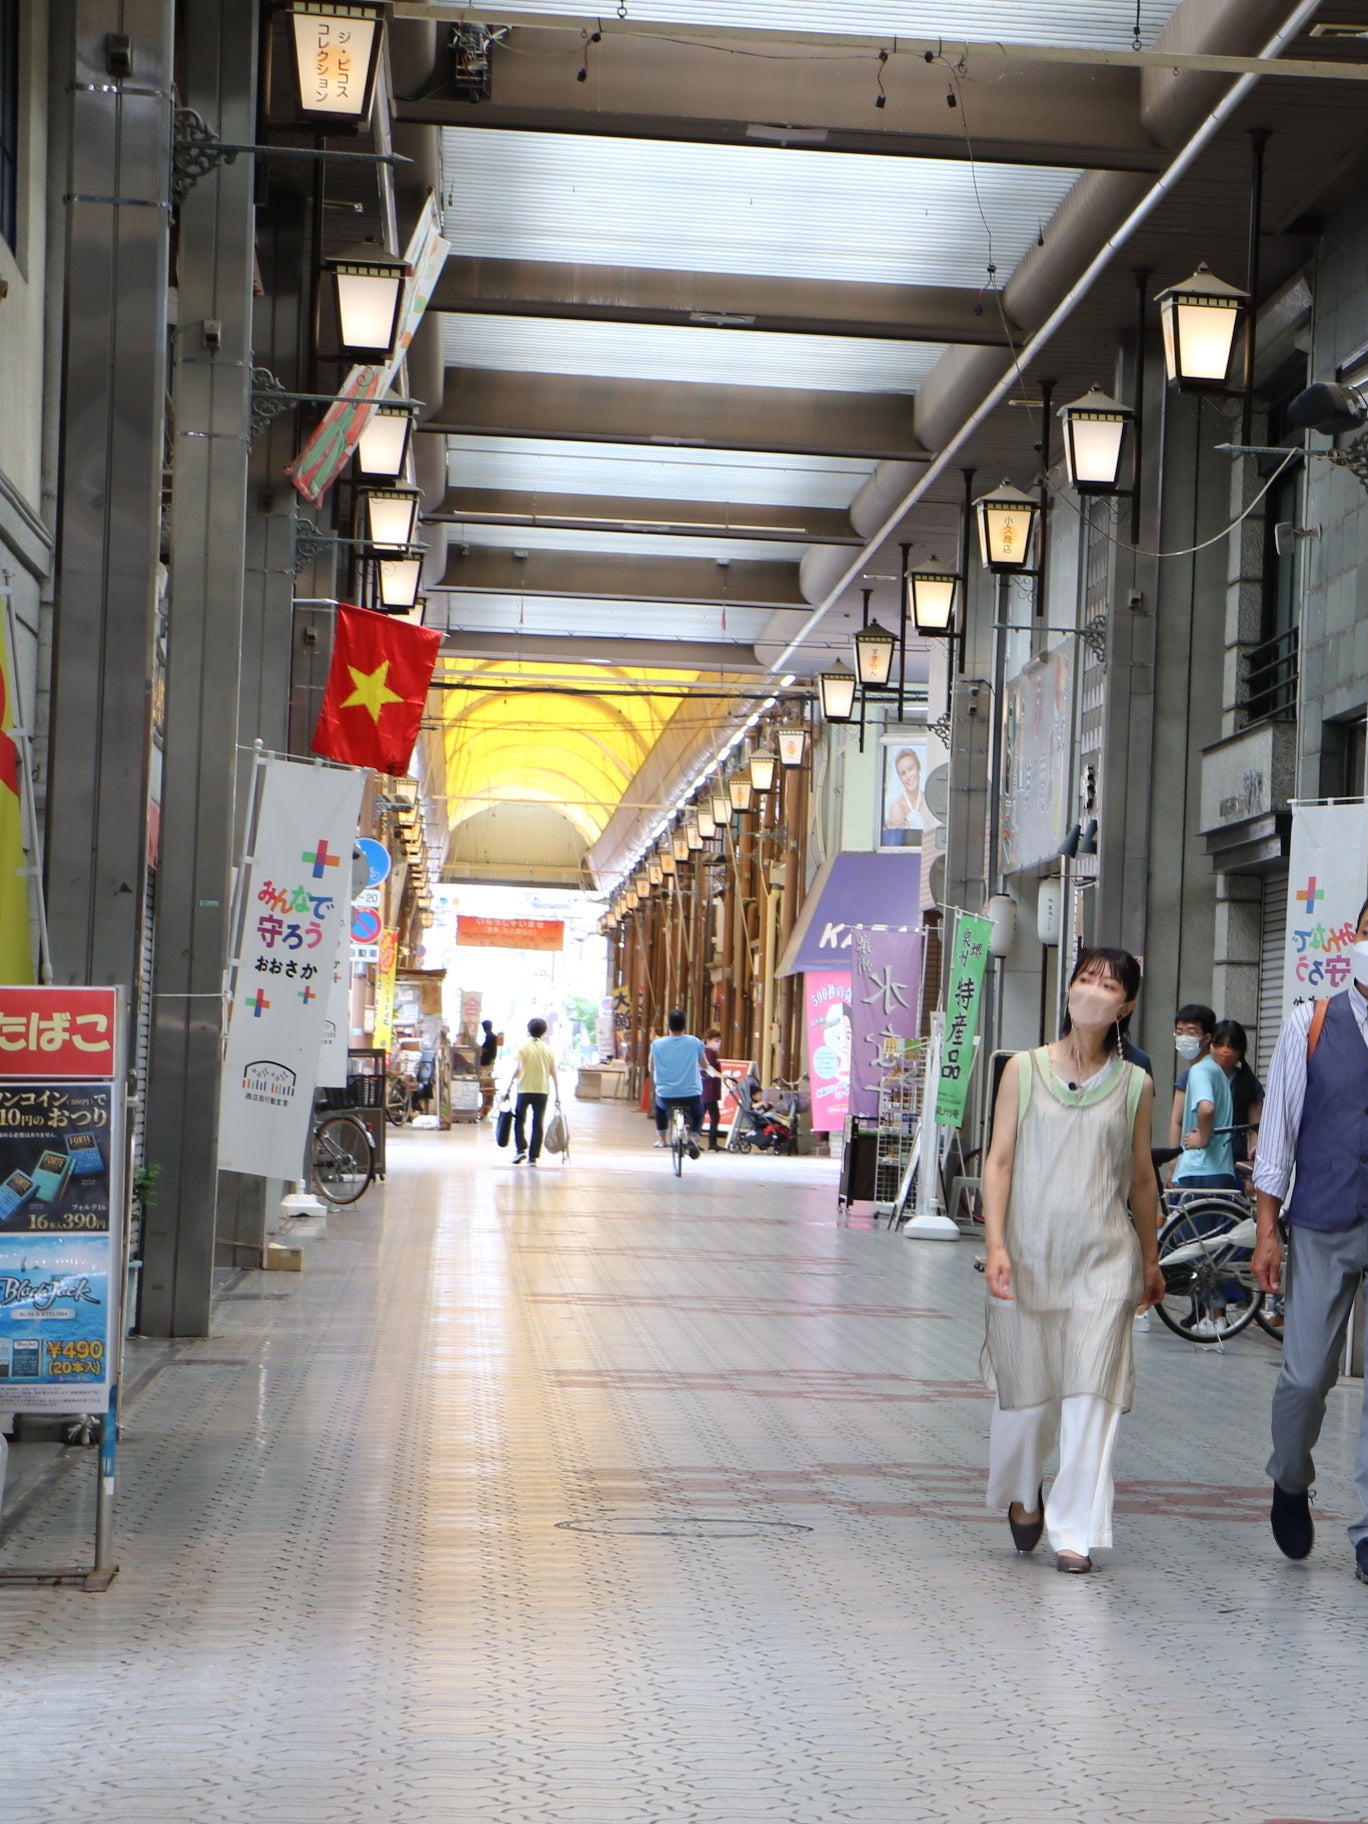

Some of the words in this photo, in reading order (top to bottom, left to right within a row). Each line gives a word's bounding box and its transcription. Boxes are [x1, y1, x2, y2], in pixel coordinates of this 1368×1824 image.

[315, 23, 330, 103] コレクション
[257, 880, 334, 920] みんなで
[257, 914, 323, 950] 守ろう
[254, 955, 318, 980] おおさか
[941, 976, 975, 1080] 特産品
[69, 1134, 92, 1146] FORTE
[43, 1153, 66, 1169] FORTE
[47, 1340, 104, 1360] ¥490
[48, 1361, 101, 1376] (20本入)
